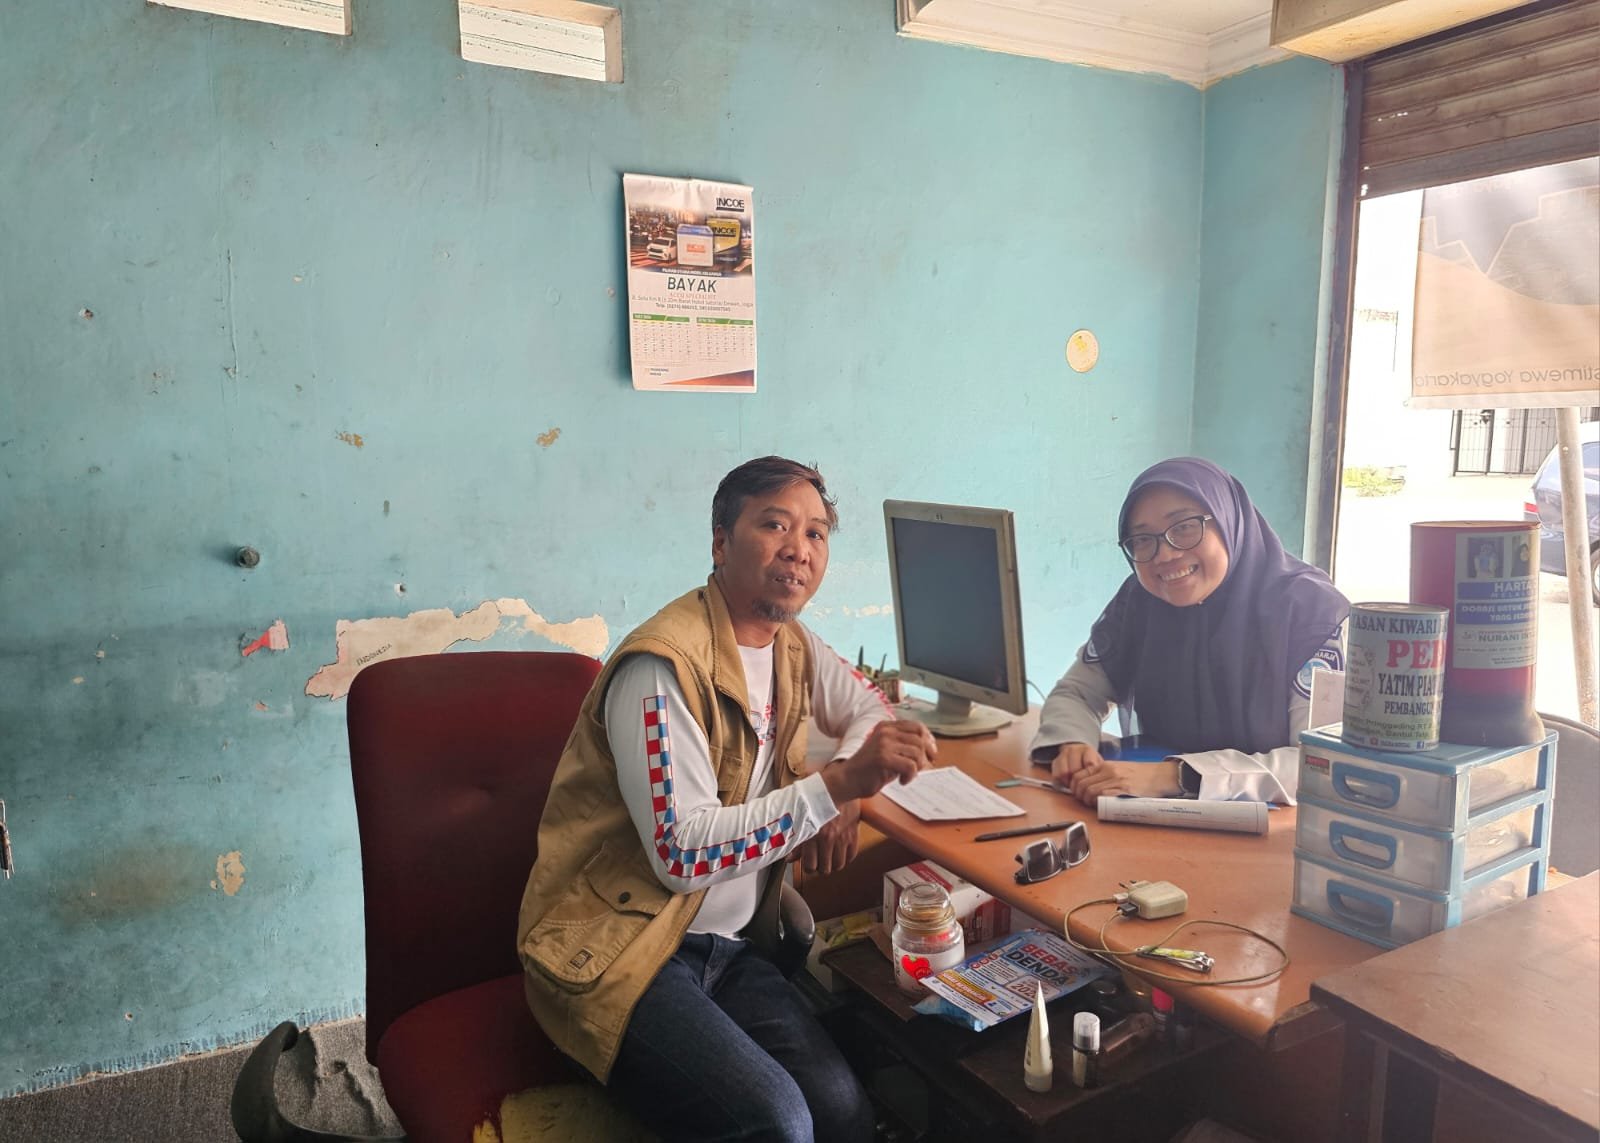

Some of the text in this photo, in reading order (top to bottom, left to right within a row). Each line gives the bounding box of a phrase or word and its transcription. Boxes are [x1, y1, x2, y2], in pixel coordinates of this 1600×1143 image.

[715, 197, 745, 209] INCOE
[667, 277, 717, 293] BAYAK
[1388, 618, 1438, 635] KIWARI
[1378, 673, 1416, 697] YATIM
[1007, 950, 1069, 987] DENDA
[1021, 943, 1079, 975] BEBAS
